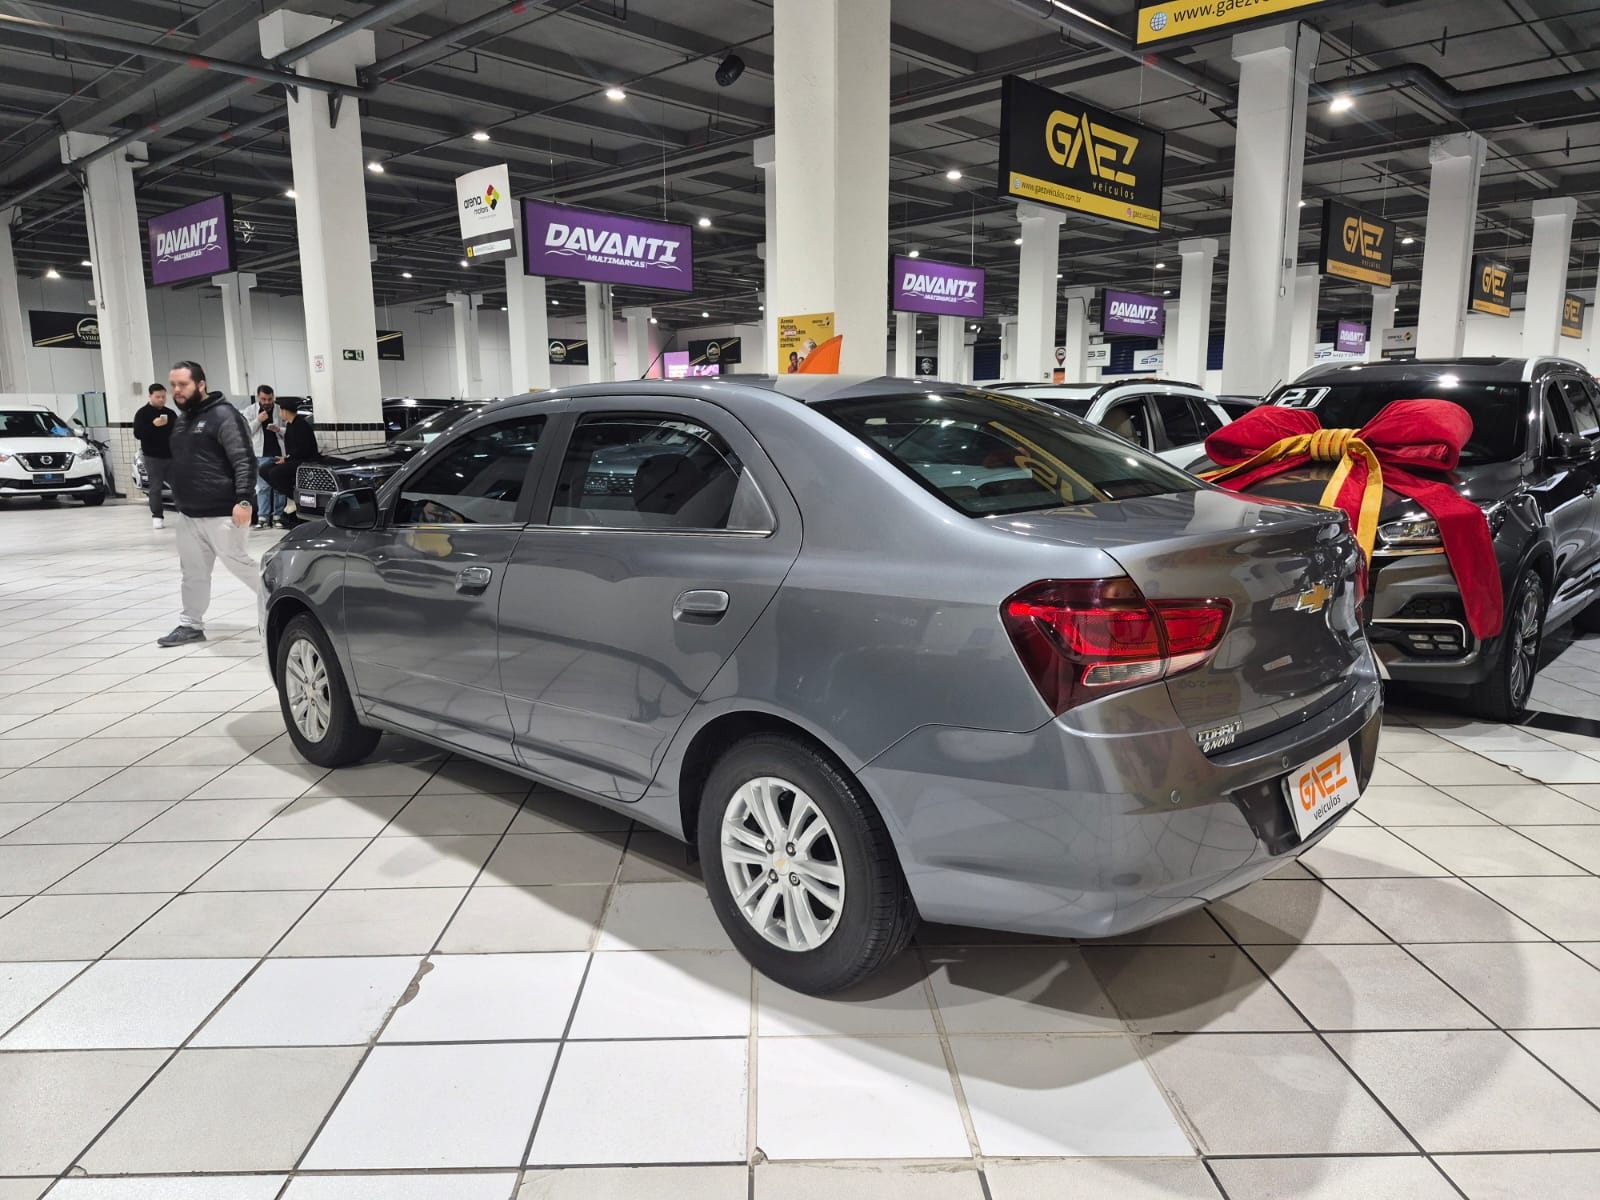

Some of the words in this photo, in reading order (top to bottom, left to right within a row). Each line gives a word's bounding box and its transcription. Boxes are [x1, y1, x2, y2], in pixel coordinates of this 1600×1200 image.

[1045, 110, 1139, 187] GAEZ
[156, 217, 219, 257] DAVANTI
[545, 222, 680, 262] DAVANTI
[1343, 215, 1385, 261] GAEZ
[586, 254, 646, 268] MULTIMARCAS
[902, 273, 977, 298] DAVANTI
[1482, 265, 1508, 298] GAEZ
[1110, 301, 1159, 320] DAVANTI
[1299, 751, 1349, 812] GAEZ
